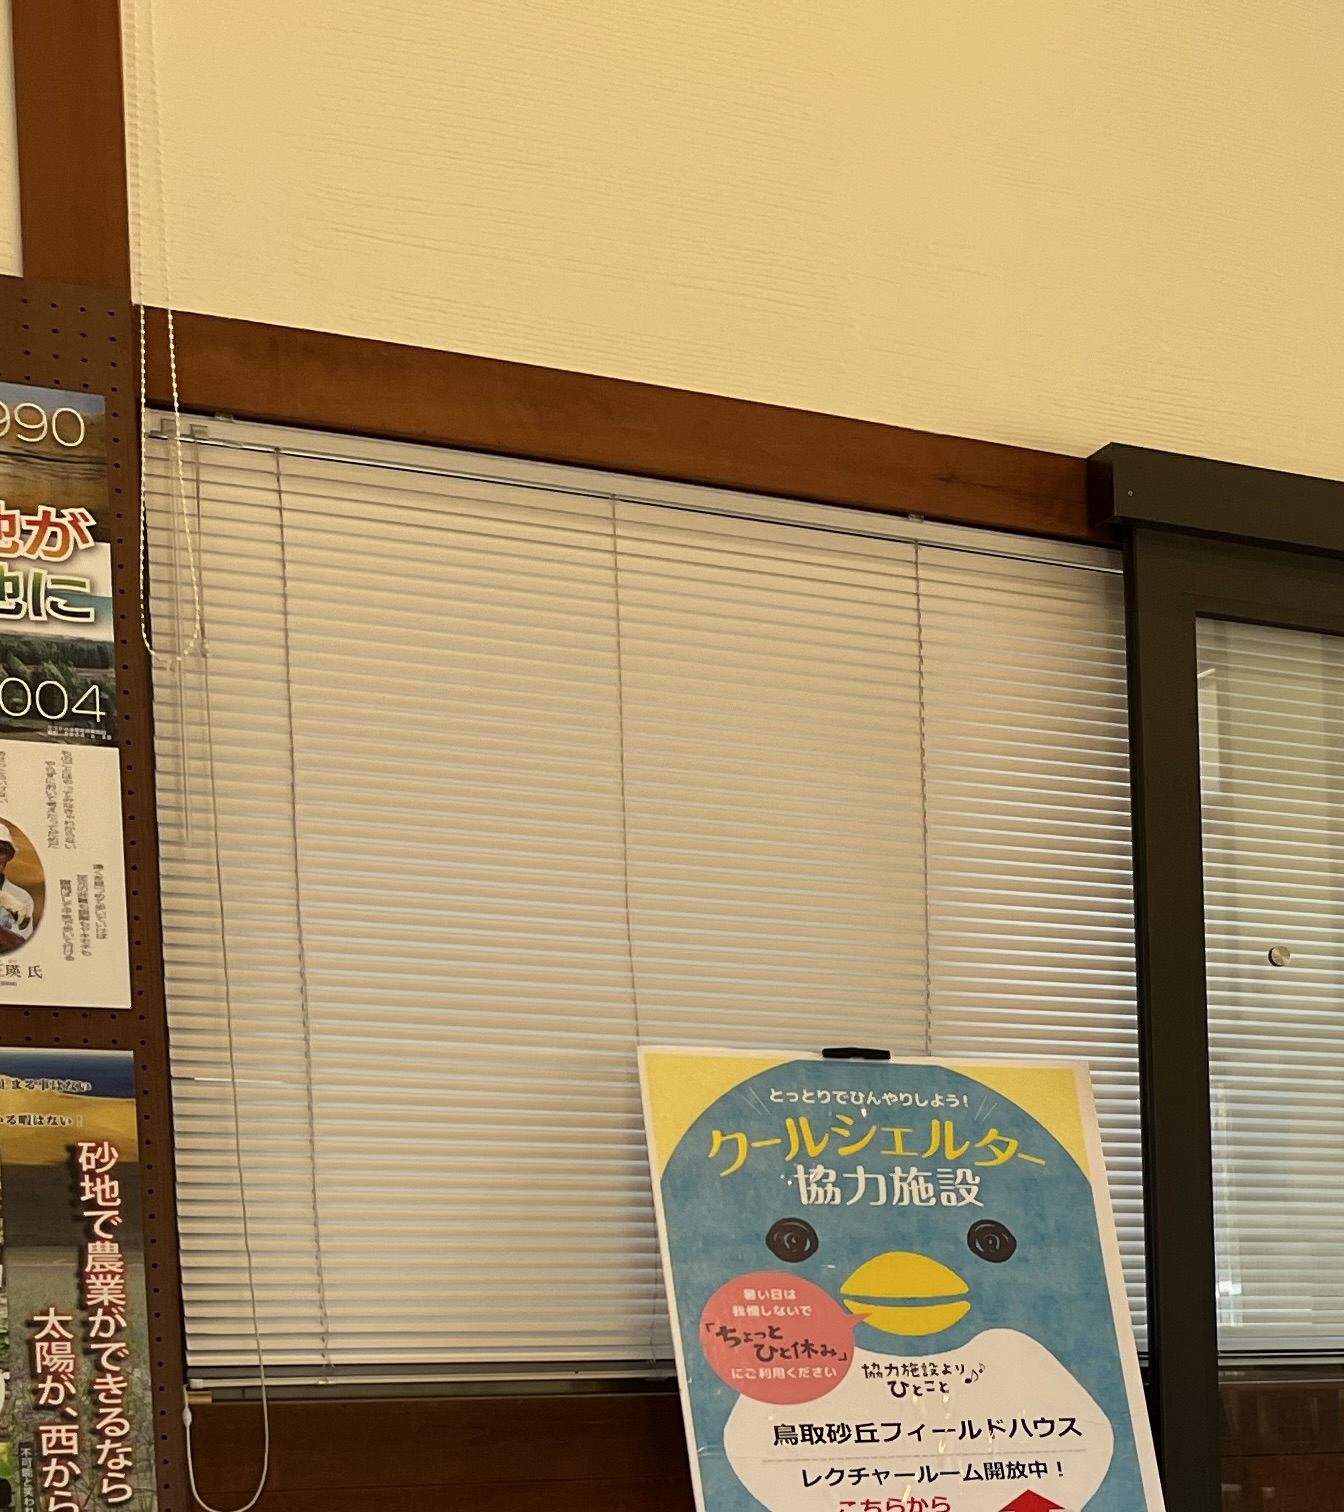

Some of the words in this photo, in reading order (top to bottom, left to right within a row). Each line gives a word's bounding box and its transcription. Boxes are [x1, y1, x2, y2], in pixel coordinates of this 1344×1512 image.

[28, 965, 43, 979] 氏
[769, 1087, 969, 1108] とっとりでひんやりしよう!
[708, 1114, 1046, 1177] クールシェルター
[793, 1164, 985, 1207] 協力施設
[743, 1289, 797, 1300] 暑い日は
[732, 1305, 812, 1317] 我慢しないで
[77, 1141, 133, 1504] 砂地で農業ができるなら
[705, 1323, 783, 1348] 「ちょっと
[754, 1339, 848, 1362] ひと休み」
[731, 1367, 837, 1380] にご利用ください
[862, 1363, 965, 1379] 協力施設より
[888, 1380, 950, 1398] ひとこと
[773, 1416, 1082, 1447] 鳥取砂丘フィールドハウス
